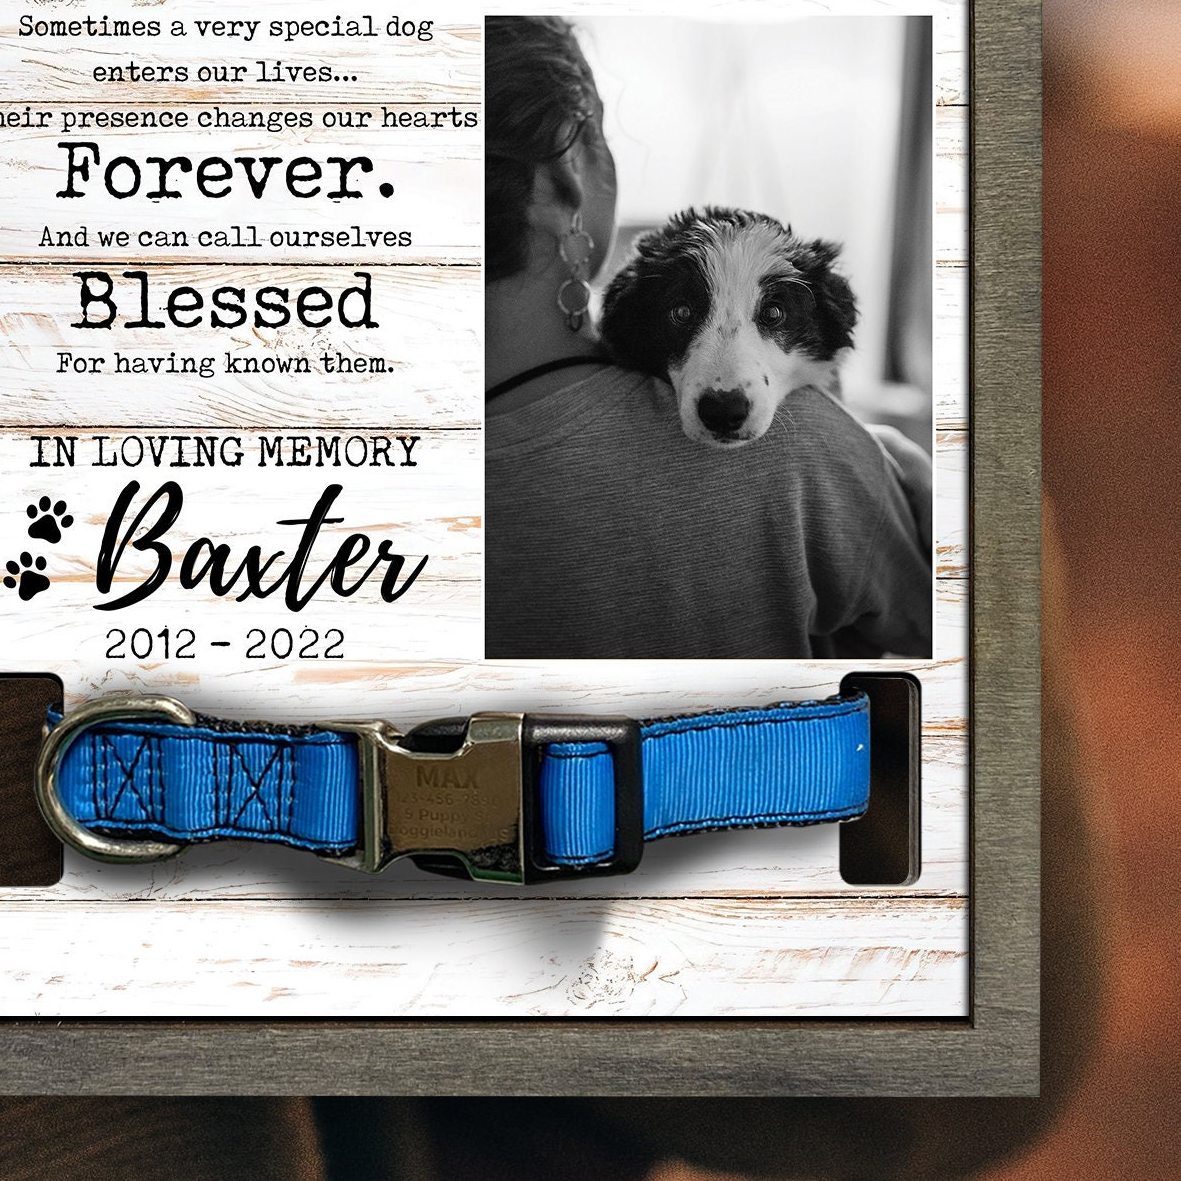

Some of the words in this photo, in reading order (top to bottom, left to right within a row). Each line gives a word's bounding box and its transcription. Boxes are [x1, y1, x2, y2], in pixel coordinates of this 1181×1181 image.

[18, 15, 161, 37] Sometimes
[170, 20, 188, 37] a
[193, 20, 261, 42] very
[269, 15, 378, 42] special
[386, 15, 434, 42] dog
[93, 60, 189, 83] enters
[197, 66, 248, 83] our
[255, 60, 358, 83] lives...
[60, 111, 189, 133] presence
[197, 106, 313, 133] changes
[322, 111, 373, 128] our
[380, 106, 478, 128] hearts
[55, 141, 395, 200] Forever.
[38, 225, 90, 247] And
[97, 231, 130, 247] we
[138, 230, 189, 247] can
[198, 225, 263, 247] call
[270, 225, 412, 247] ourselves
[70, 270, 380, 331] Blessed
[56, 352, 106, 374] For
[113, 351, 216, 379] having
[224, 352, 312, 374] known
[319, 352, 394, 374] them.
[29, 435, 79, 468] IN
[91, 435, 245, 468] LOVING
[257, 435, 421, 468] MEMORY
[92, 479, 429, 613] Baxter
[105, 627, 196, 660] 2012
[245, 627, 345, 660] 2022
[416, 765, 480, 789] MAX
[419, 808, 468, 824] Puppy
